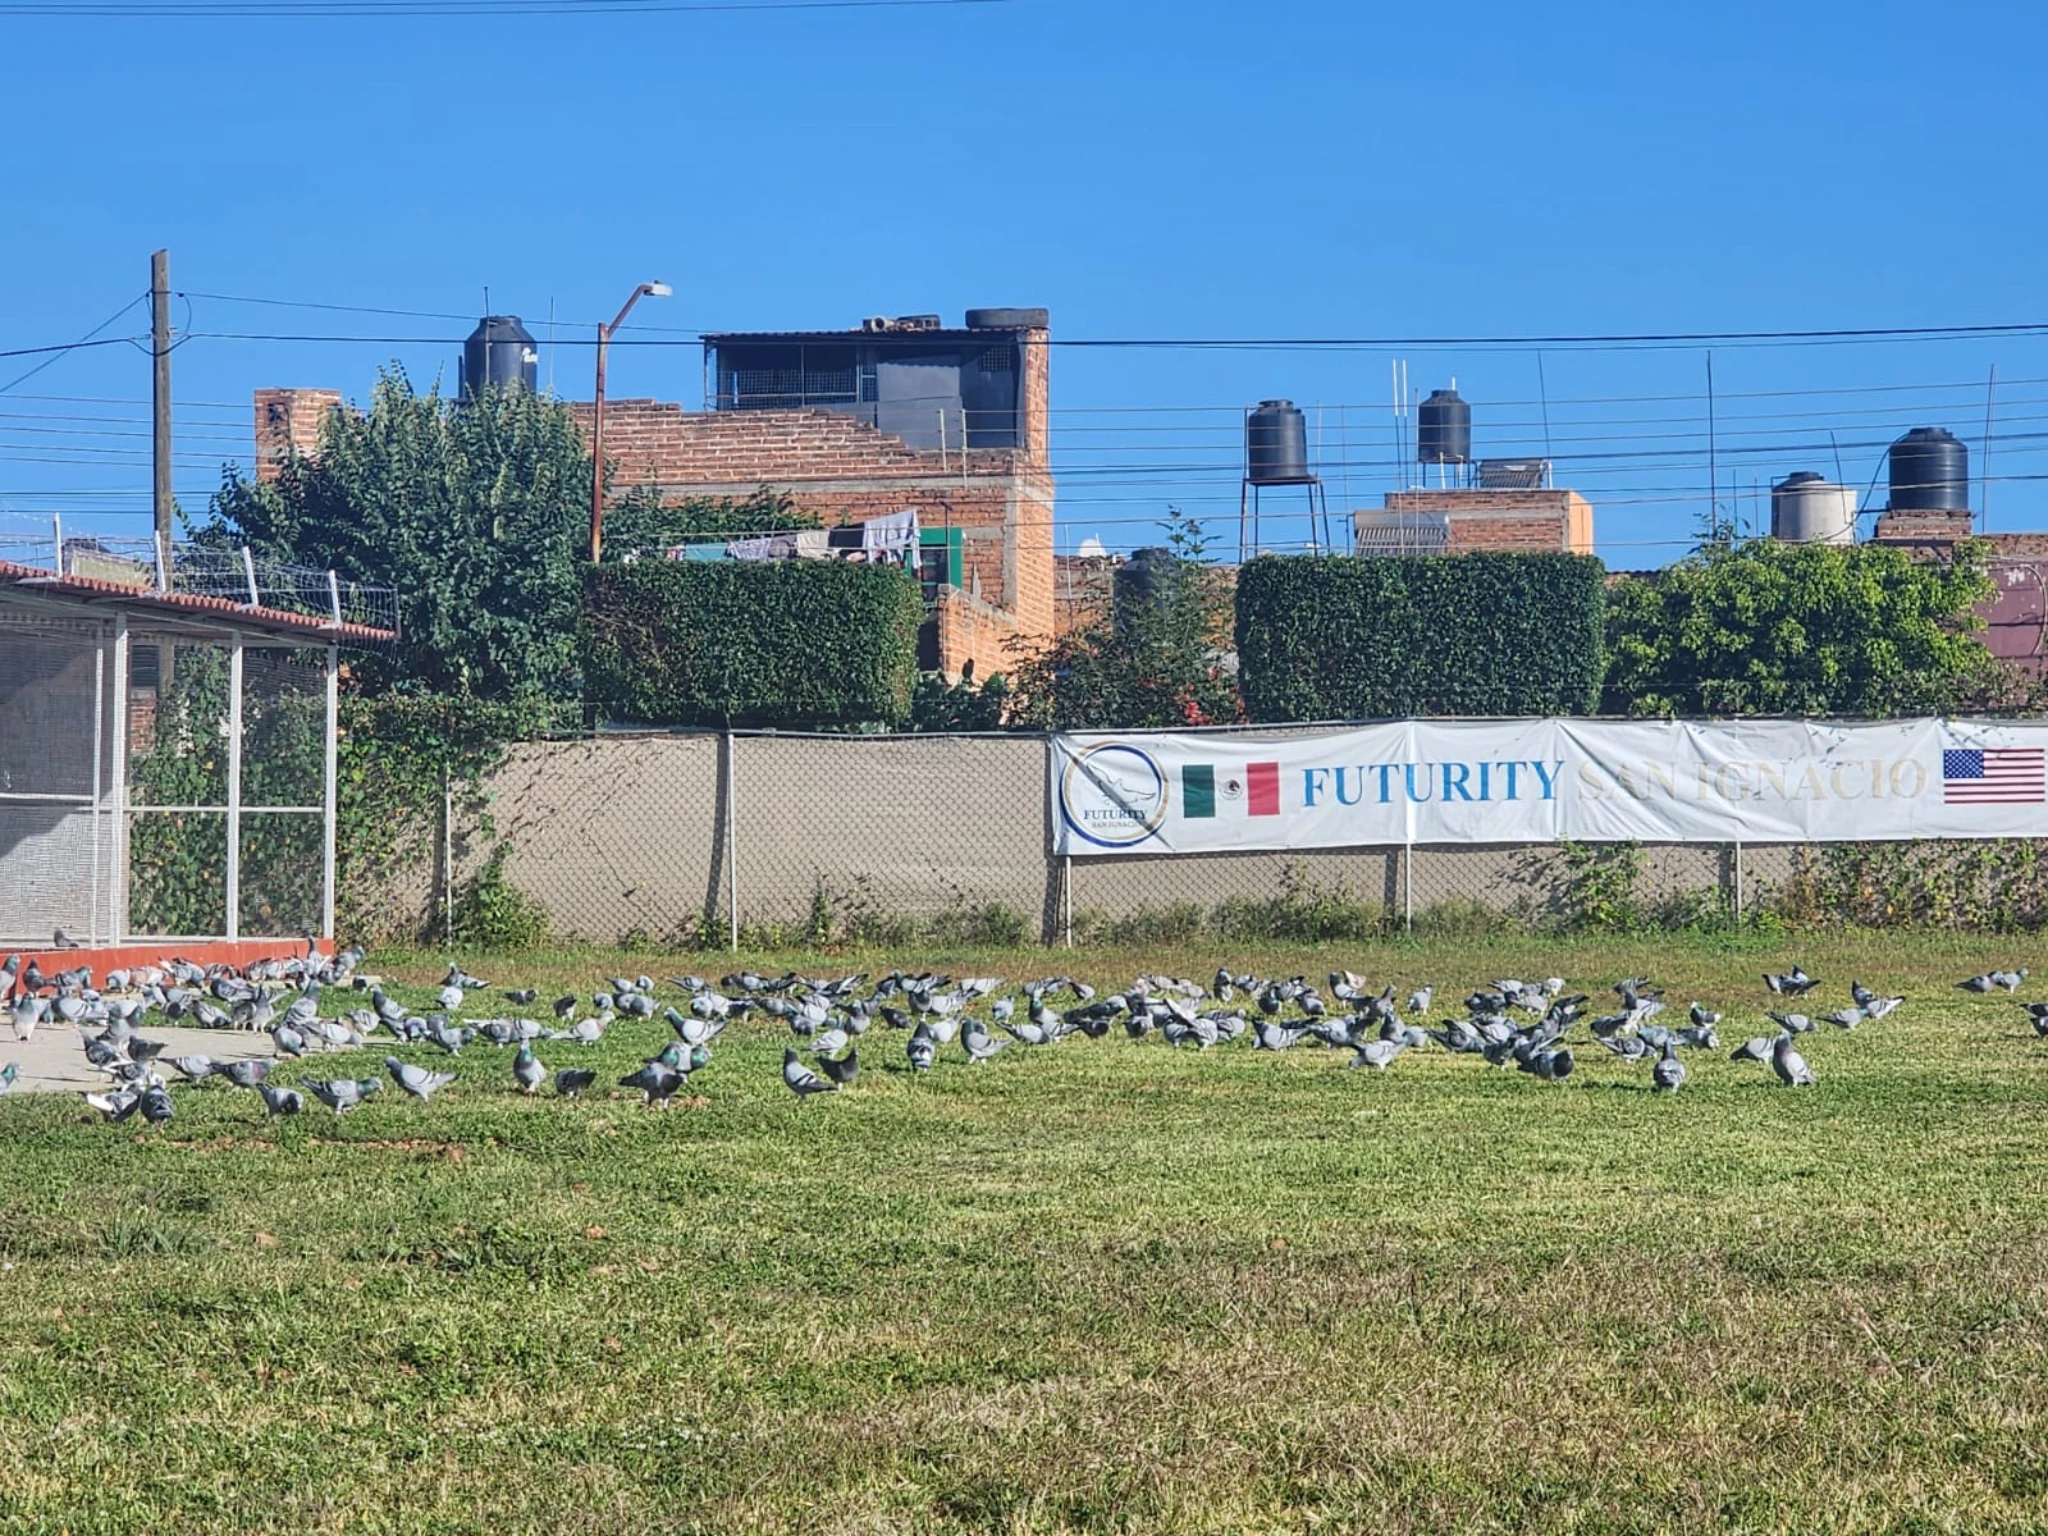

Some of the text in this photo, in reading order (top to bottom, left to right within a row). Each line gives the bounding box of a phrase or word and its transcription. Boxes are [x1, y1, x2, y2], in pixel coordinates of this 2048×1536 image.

[1302, 758, 1929, 807] FUTURITY SAN IGNACIO
[1084, 809, 1148, 820] FUTURITY
